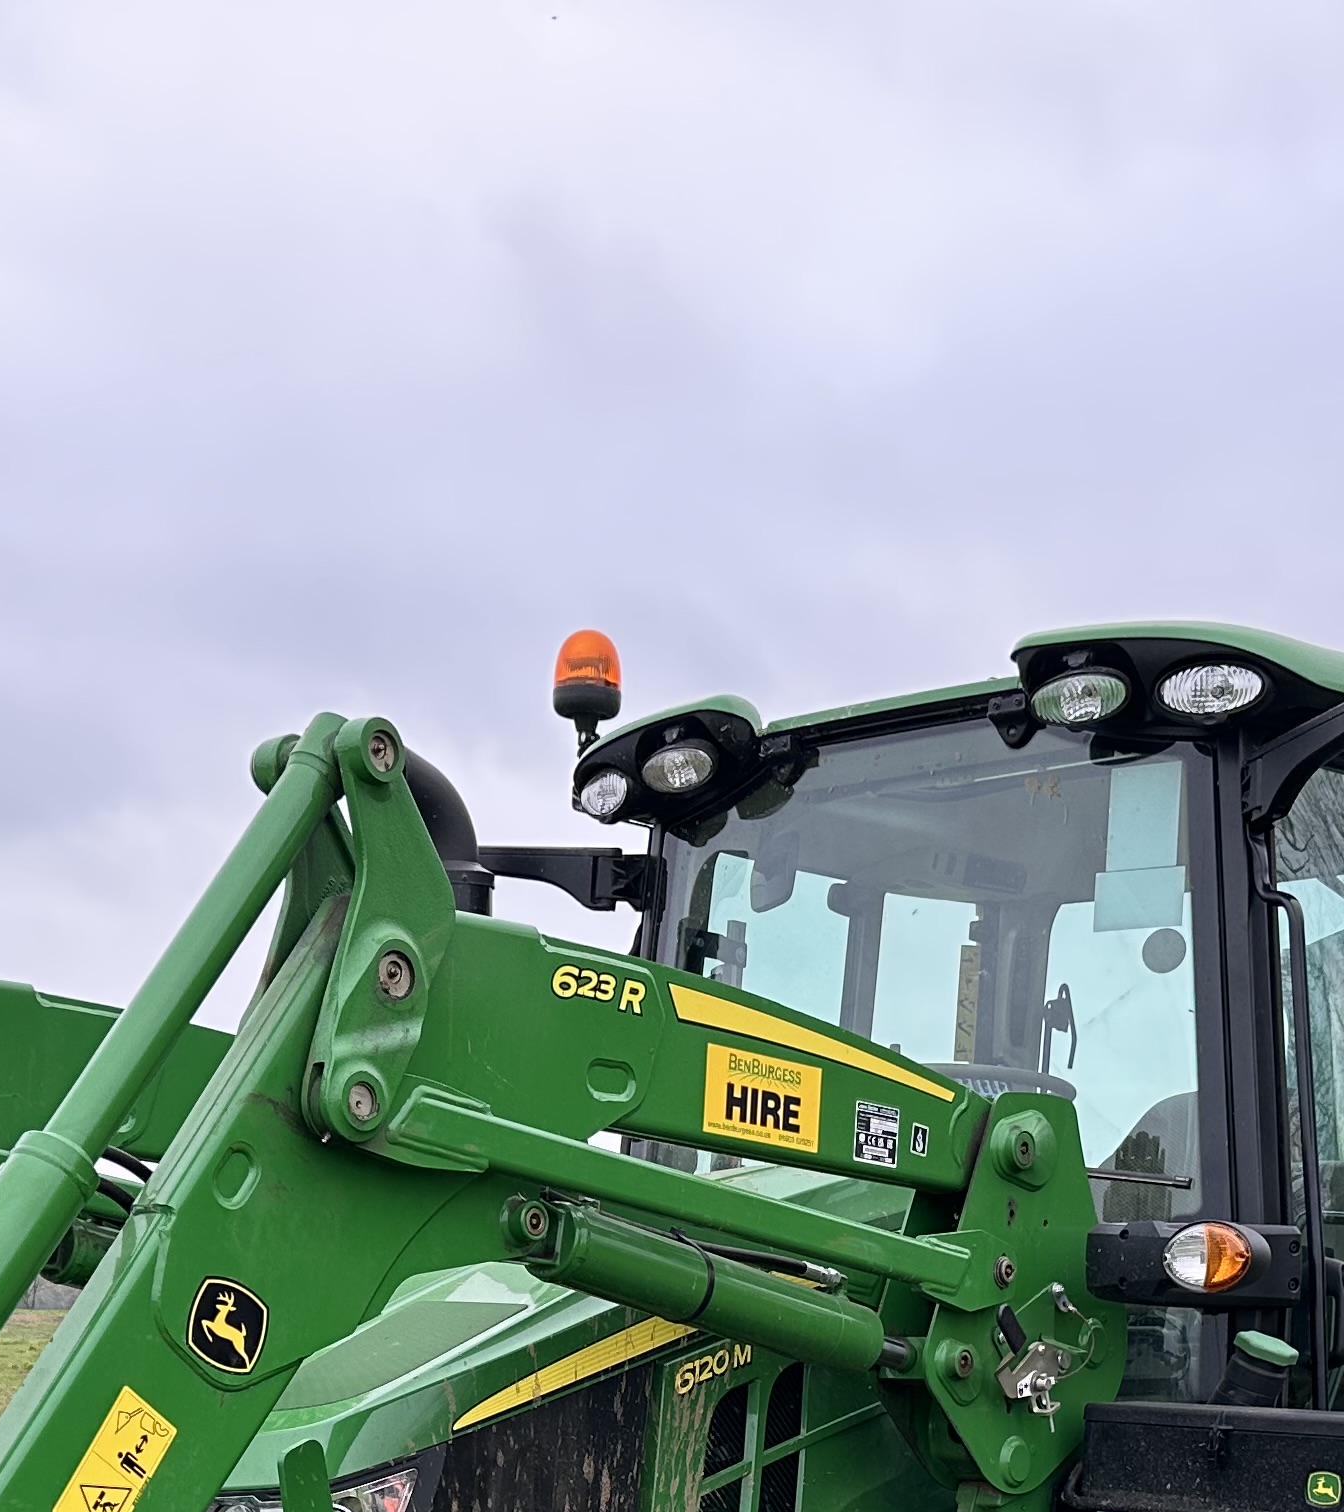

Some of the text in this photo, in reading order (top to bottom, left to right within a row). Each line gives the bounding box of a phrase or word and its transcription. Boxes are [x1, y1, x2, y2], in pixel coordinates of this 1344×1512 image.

[551, 963, 647, 1017] 623 R
[725, 1081, 802, 1134] HIRE
[674, 1343, 752, 1395] 6120 M
